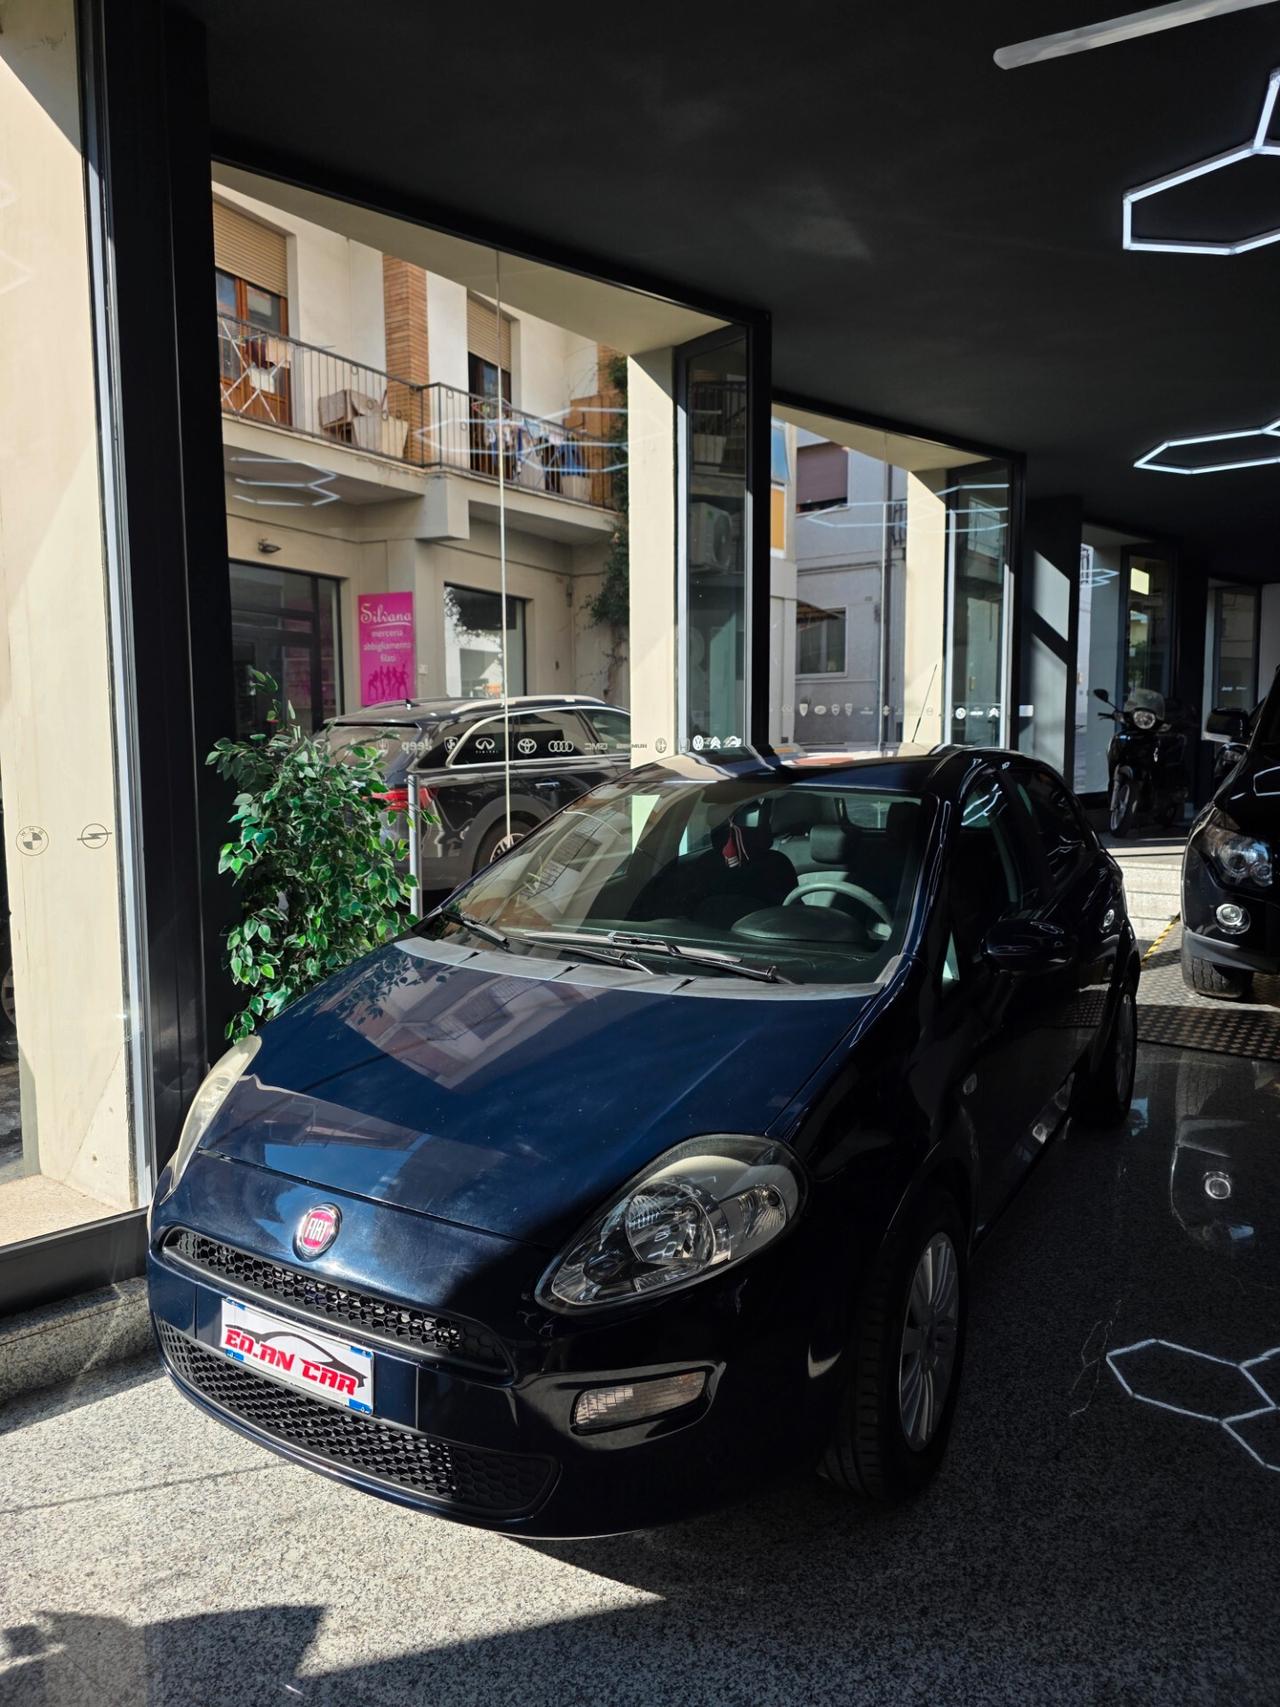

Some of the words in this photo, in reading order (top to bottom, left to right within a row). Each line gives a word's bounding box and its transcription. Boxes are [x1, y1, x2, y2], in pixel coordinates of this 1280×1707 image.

[361, 603, 411, 624] Silvana
[304, 1217, 333, 1242] FIAT
[225, 1328, 295, 1372] ED.AN
[299, 1358, 358, 1396] CAR
